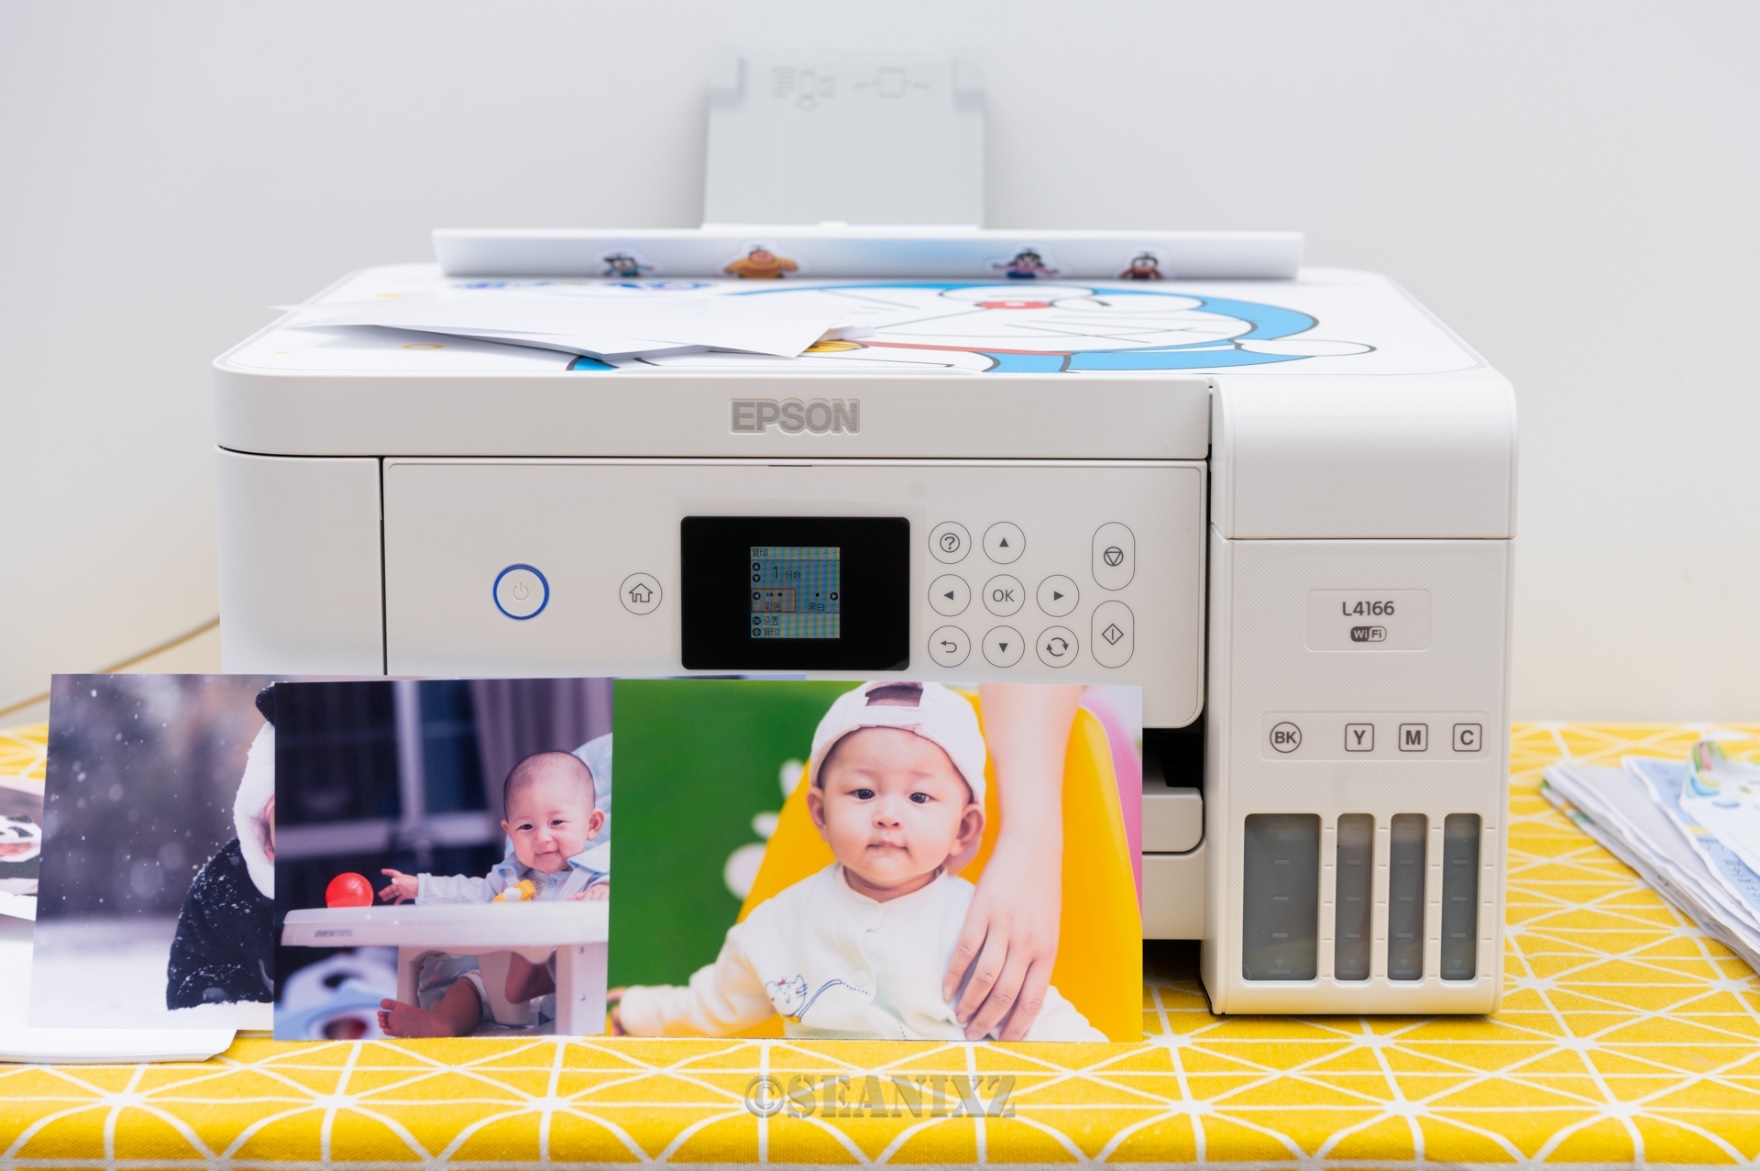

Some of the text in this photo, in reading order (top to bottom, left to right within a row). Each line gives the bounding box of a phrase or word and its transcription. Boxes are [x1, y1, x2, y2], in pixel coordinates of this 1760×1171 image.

[731, 400, 858, 432] EPSON
[752, 548, 768, 557] 复印
[773, 565, 778, 579] 1
[992, 589, 1015, 603] OK
[764, 602, 782, 612] 彩色
[808, 602, 825, 612] 黑白
[1342, 600, 1395, 616] L4166
[763, 616, 779, 626] 设置
[763, 628, 780, 637] 复印
[1274, 729, 1474, 745] BK Y M C
